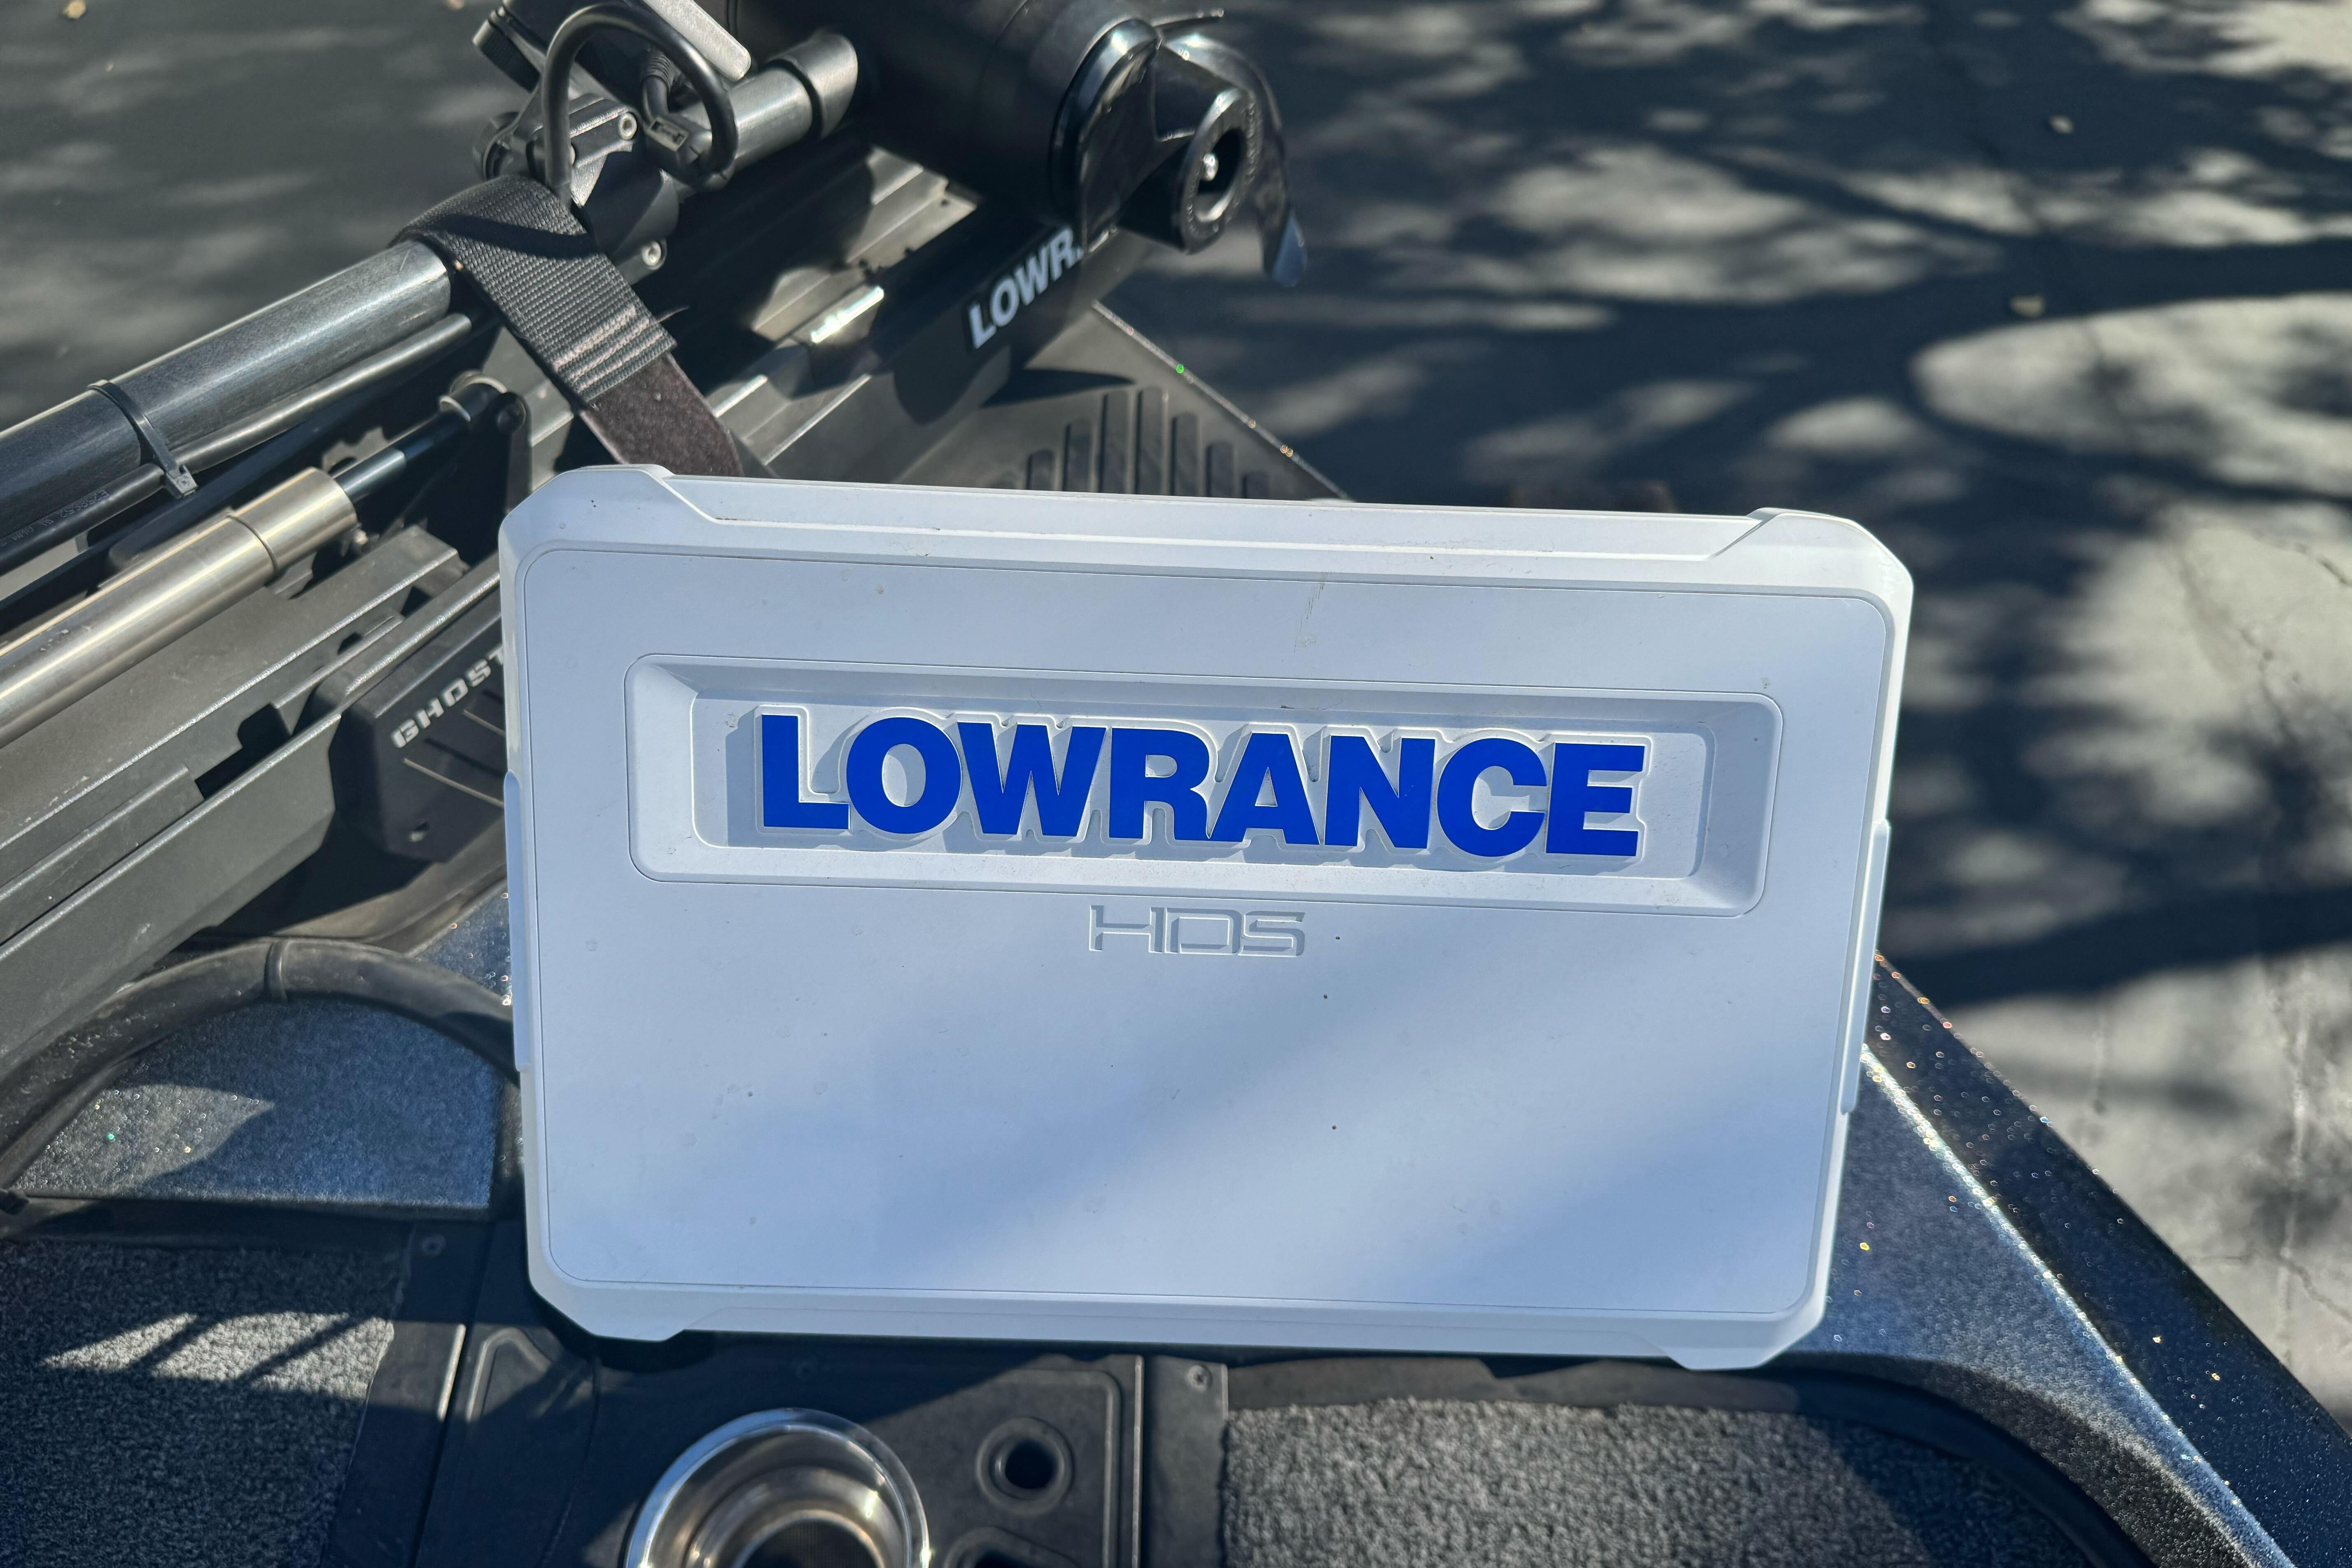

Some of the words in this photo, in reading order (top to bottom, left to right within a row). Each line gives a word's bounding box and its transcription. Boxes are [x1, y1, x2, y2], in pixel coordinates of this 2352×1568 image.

[968, 225, 1084, 349] LOWR
[761, 714, 1645, 858] LOWRANCE
[1089, 905, 1306, 957] HDS
